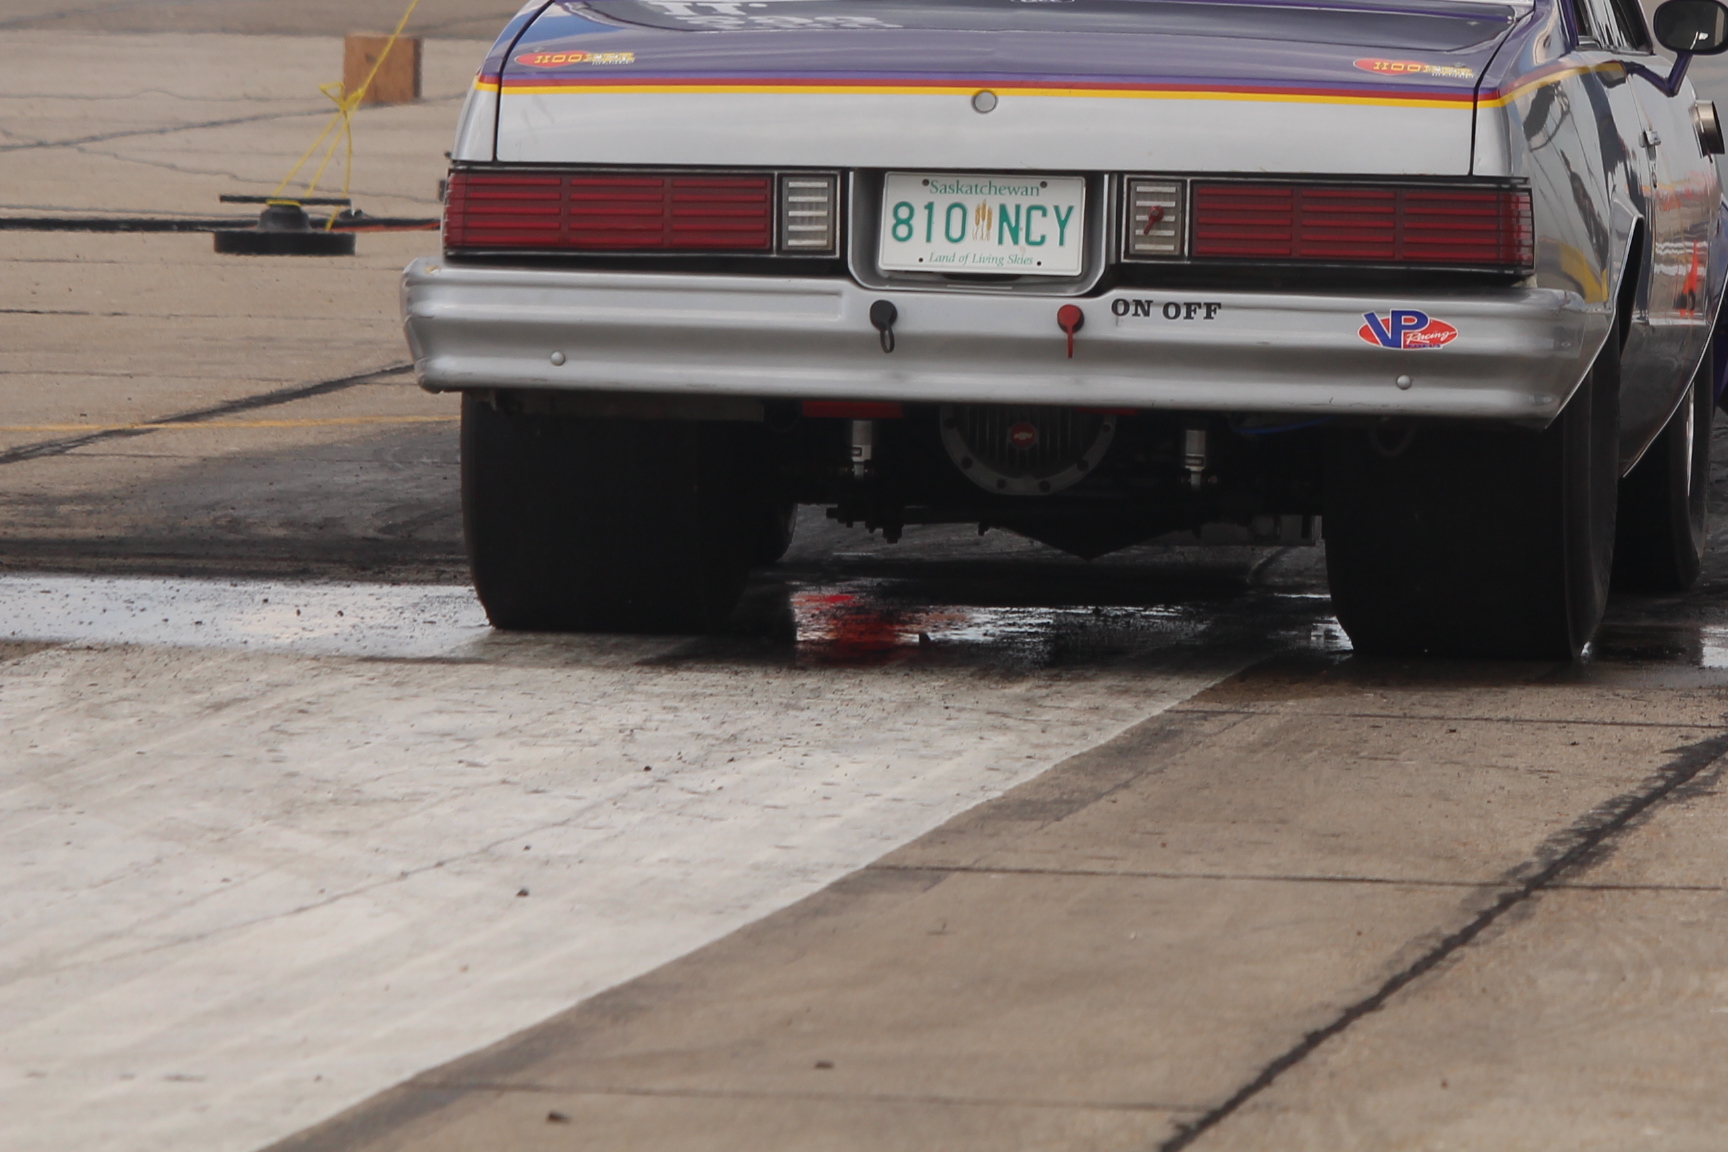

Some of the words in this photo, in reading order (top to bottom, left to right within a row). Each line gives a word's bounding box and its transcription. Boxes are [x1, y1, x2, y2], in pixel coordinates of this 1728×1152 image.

[929, 179, 1041, 197] Saskatchewan
[891, 201, 968, 244] 810
[997, 203, 1075, 247] NCY
[929, 252, 956, 263] Land
[958, 253, 970, 265] of
[971, 253, 1004, 266] Living
[1007, 253, 1034, 265] Skies
[1111, 298, 1154, 318] ON
[1162, 301, 1222, 321] OFF
[1362, 308, 1430, 349] VP
[1406, 329, 1457, 346] Racing
